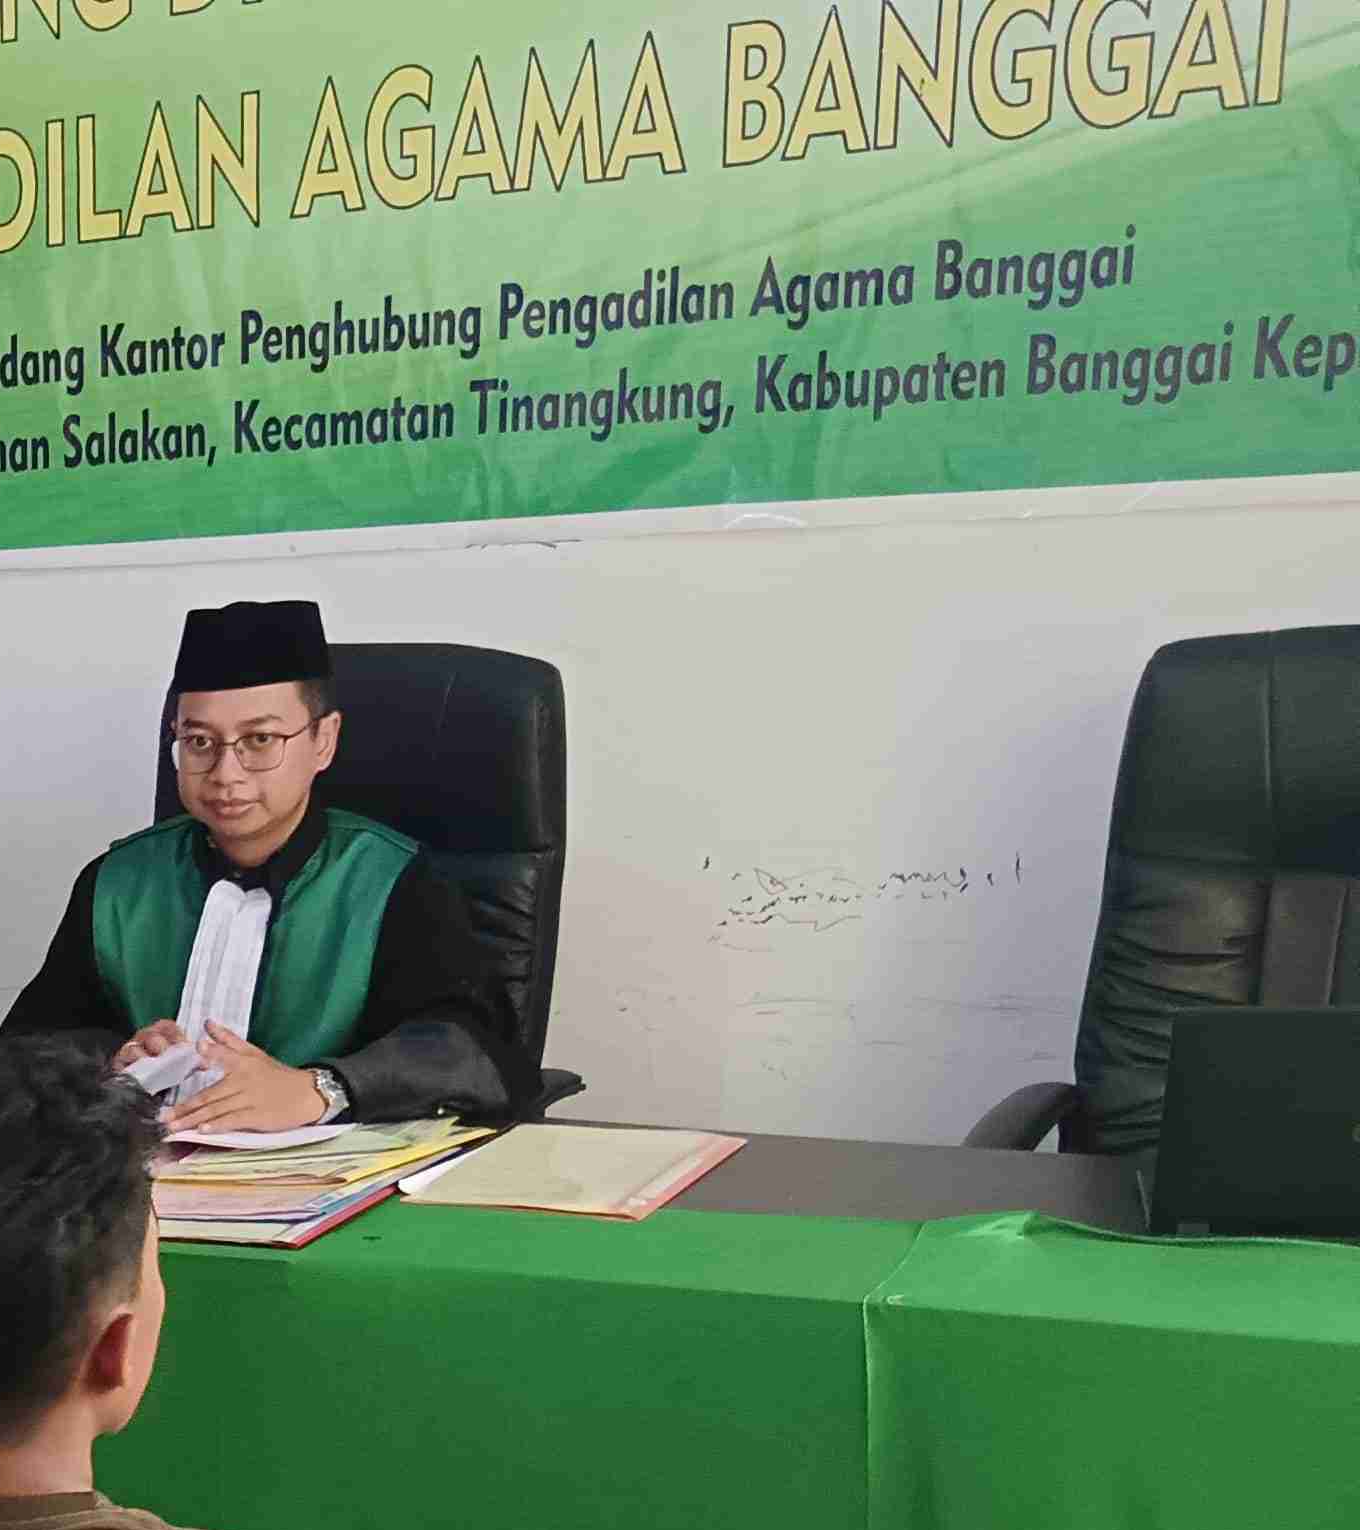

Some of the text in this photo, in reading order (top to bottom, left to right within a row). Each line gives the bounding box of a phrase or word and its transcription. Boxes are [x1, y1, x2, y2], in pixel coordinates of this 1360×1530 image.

[289, 30, 688, 220] AGAMA
[721, 0, 1291, 169] BANGGAI
[100, 322, 226, 378] Kantor
[240, 294, 482, 374] Penghubung
[498, 265, 734, 349] Pengadilan
[748, 255, 915, 331] Agama
[934, 223, 1137, 311] Banggai
[62, 407, 217, 469] Salakan,
[234, 396, 455, 454] Kecamatan
[469, 366, 735, 443] Tinangkung,
[755, 349, 1006, 422] Kabupaten
[1026, 320, 1234, 406] Banggai
[1253, 313, 1356, 392] Kep
